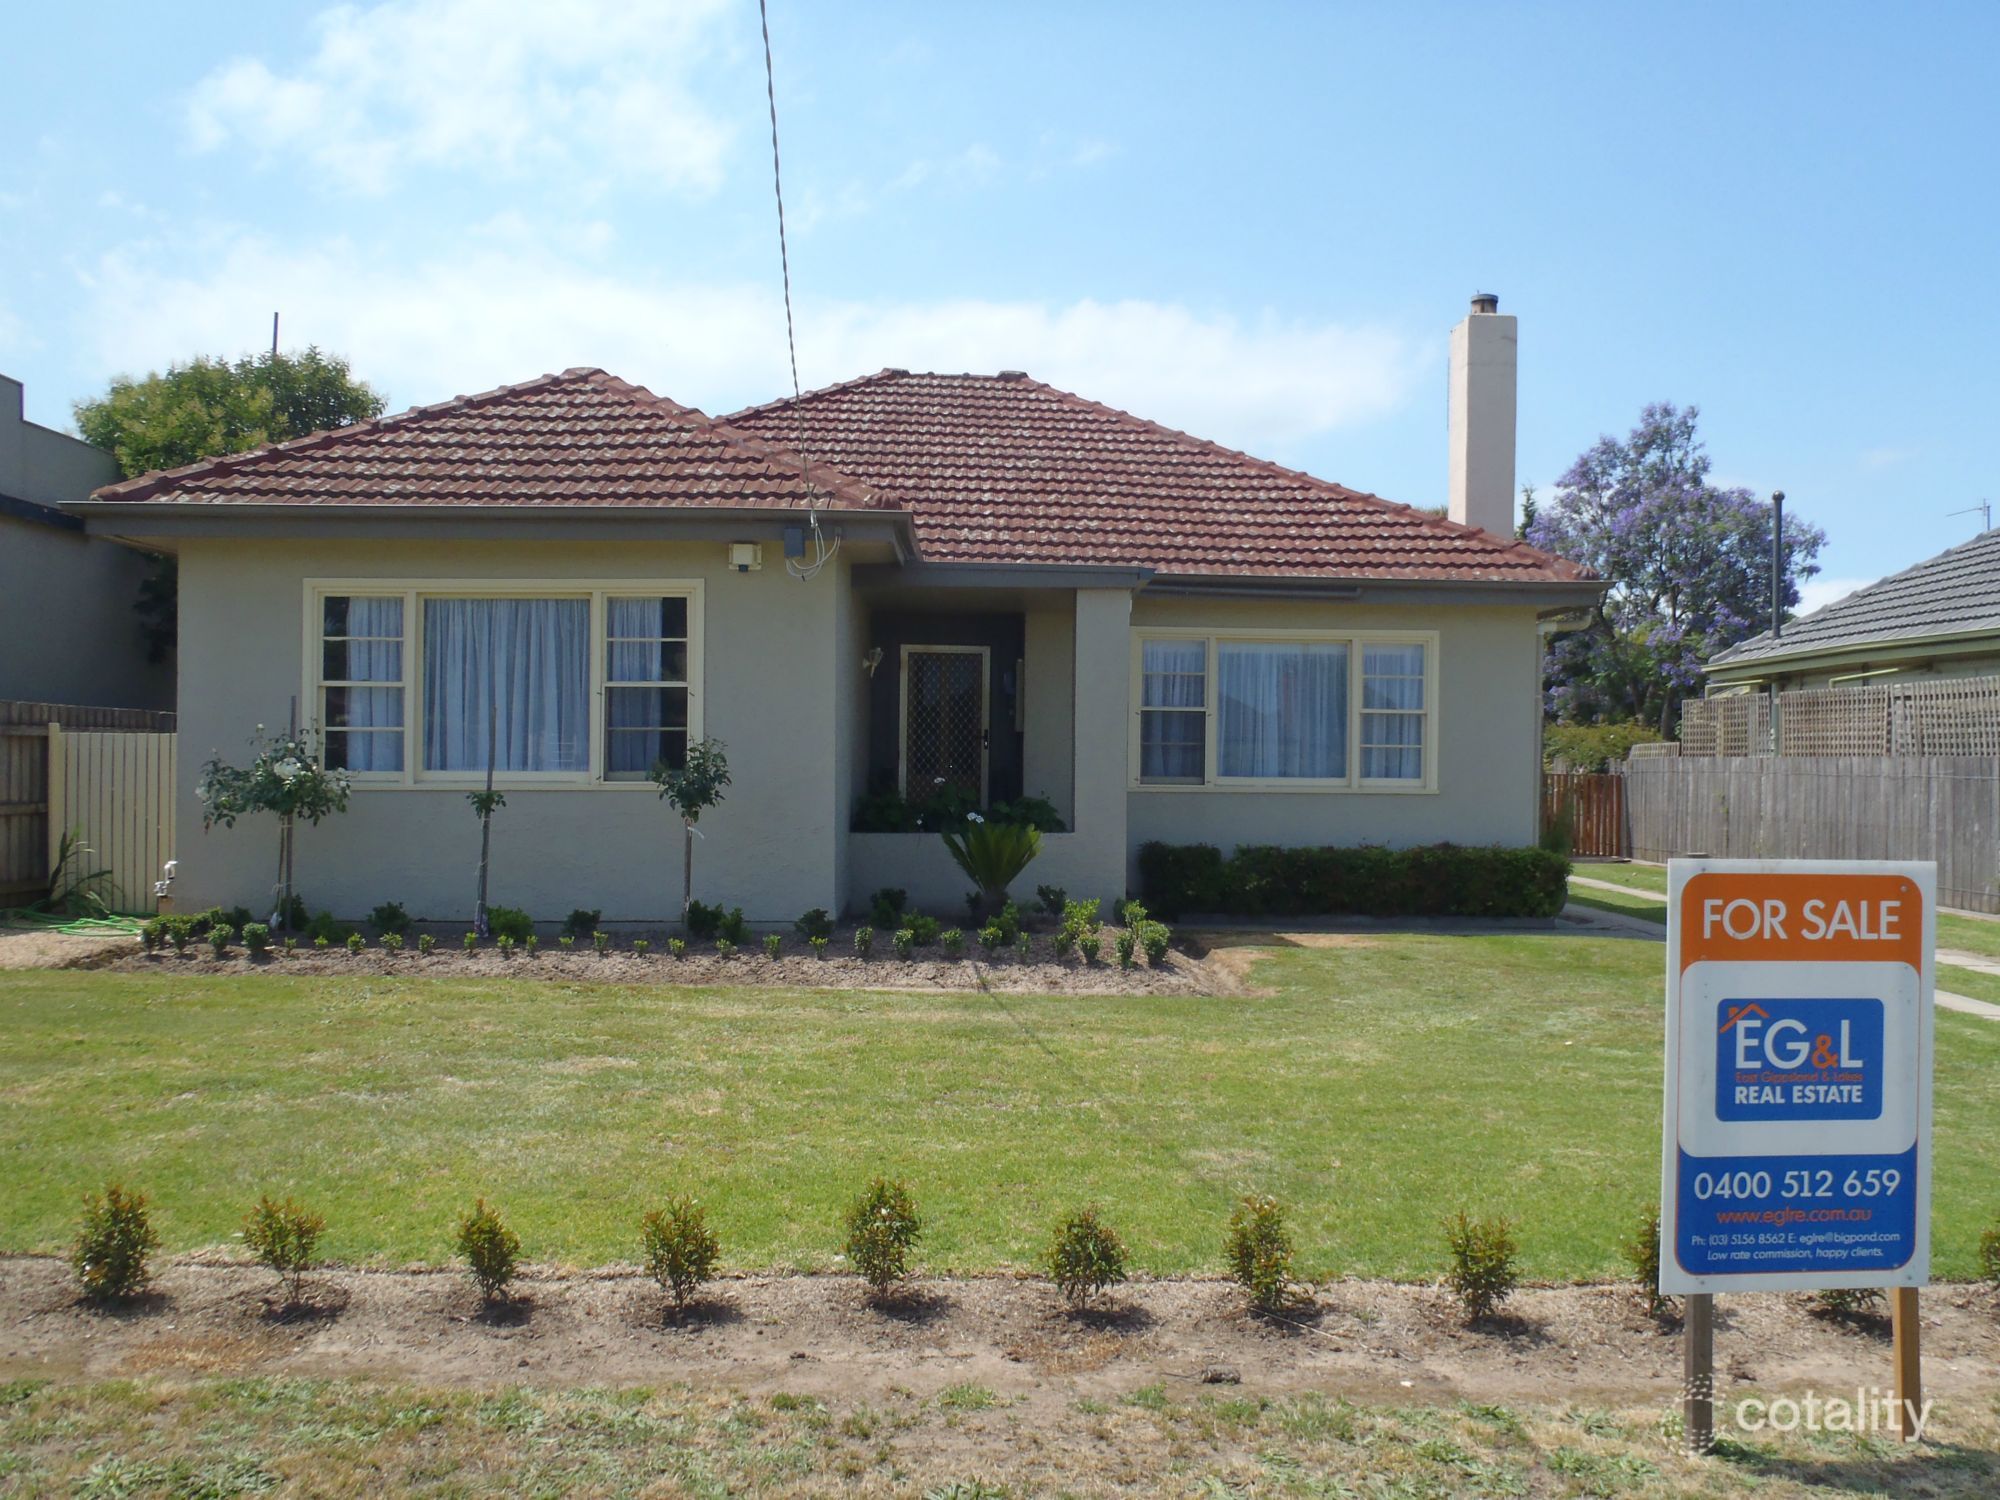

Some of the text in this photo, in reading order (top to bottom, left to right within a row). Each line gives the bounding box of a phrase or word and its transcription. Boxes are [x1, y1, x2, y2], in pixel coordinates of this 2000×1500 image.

[1703, 899, 1901, 940] FOR SALE
[1735, 1018, 1863, 1069] EG&L
[1735, 1085, 1863, 1105] REAL ESTATE
[1694, 1169, 1901, 1200] 0400 512 659
[1716, 1206, 1872, 1227] www.eglre.com.au
[1707, 1250, 1728, 1261] Low
[1815, 1247, 1848, 1259] happy
